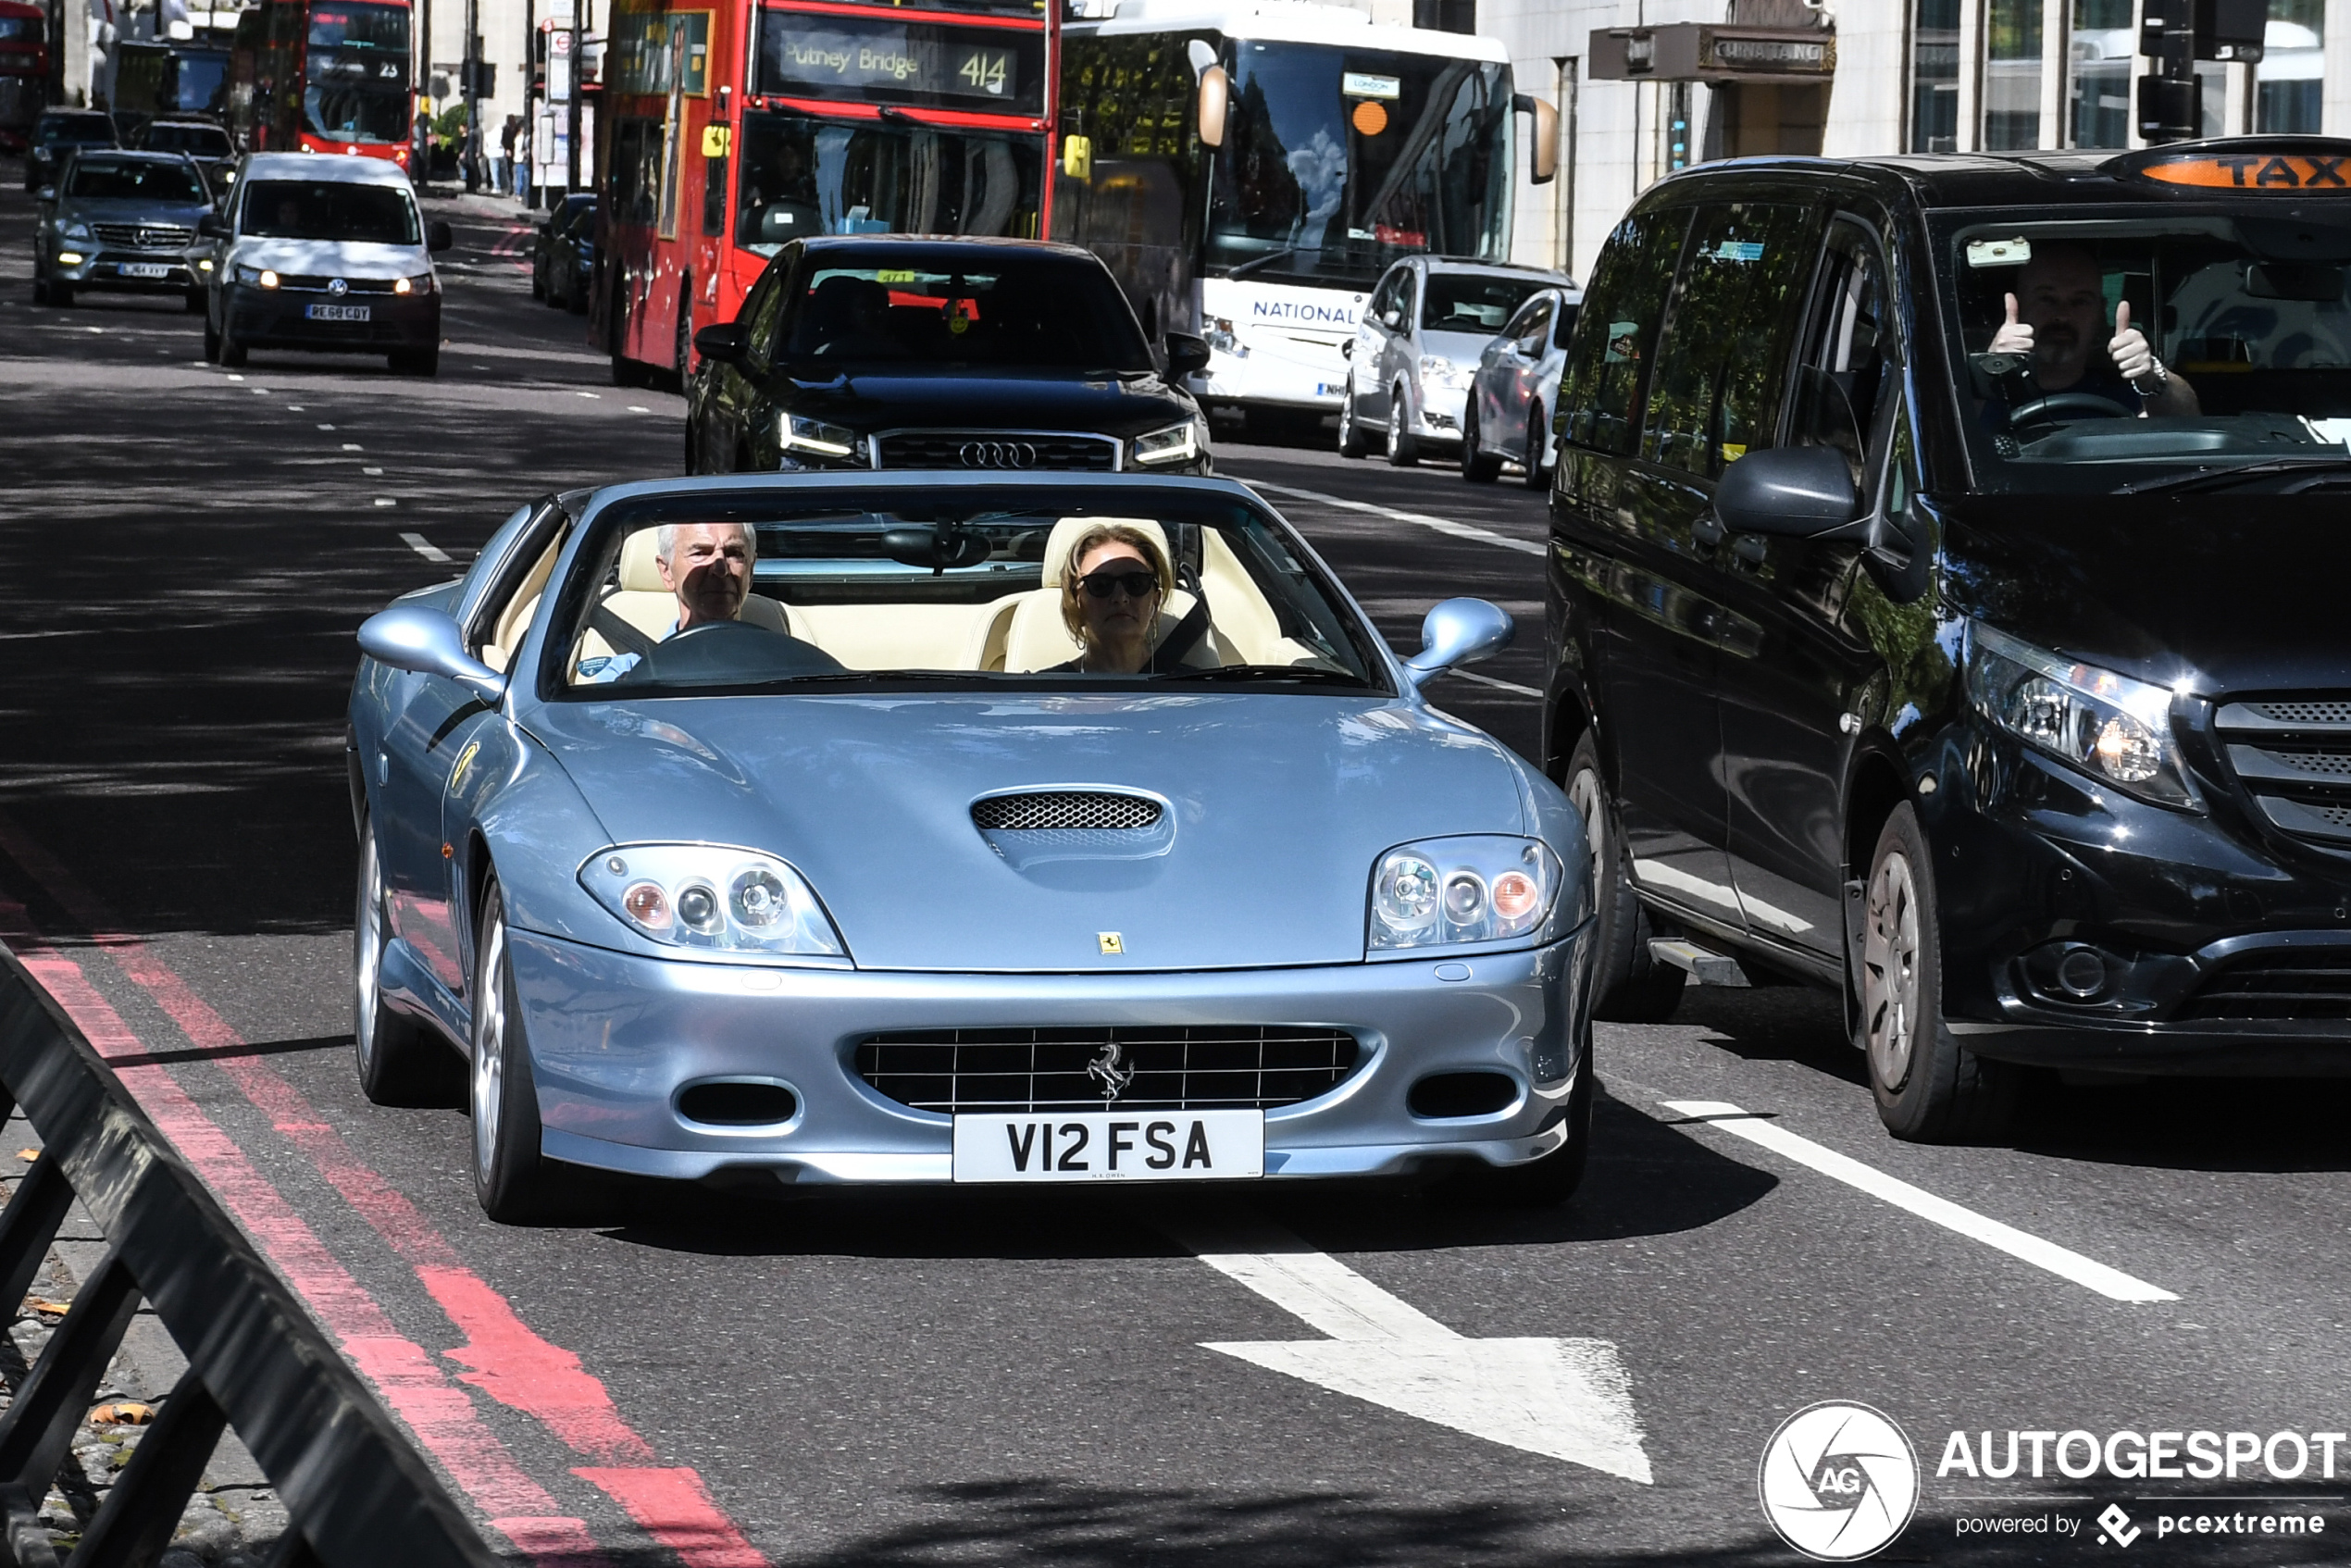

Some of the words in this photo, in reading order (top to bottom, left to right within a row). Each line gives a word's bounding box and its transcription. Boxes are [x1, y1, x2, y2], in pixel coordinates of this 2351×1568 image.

[379, 61, 398, 78] 23
[786, 43, 851, 74] Putney
[858, 48, 917, 81] Bridge
[959, 52, 1006, 87] 414
[1354, 80, 1388, 90] LONDON
[2217, 156, 2347, 187] TAX
[1253, 301, 1357, 324] NATIONAL
[1005, 1123, 1089, 1172] V12
[1108, 1120, 1213, 1171] FSA
